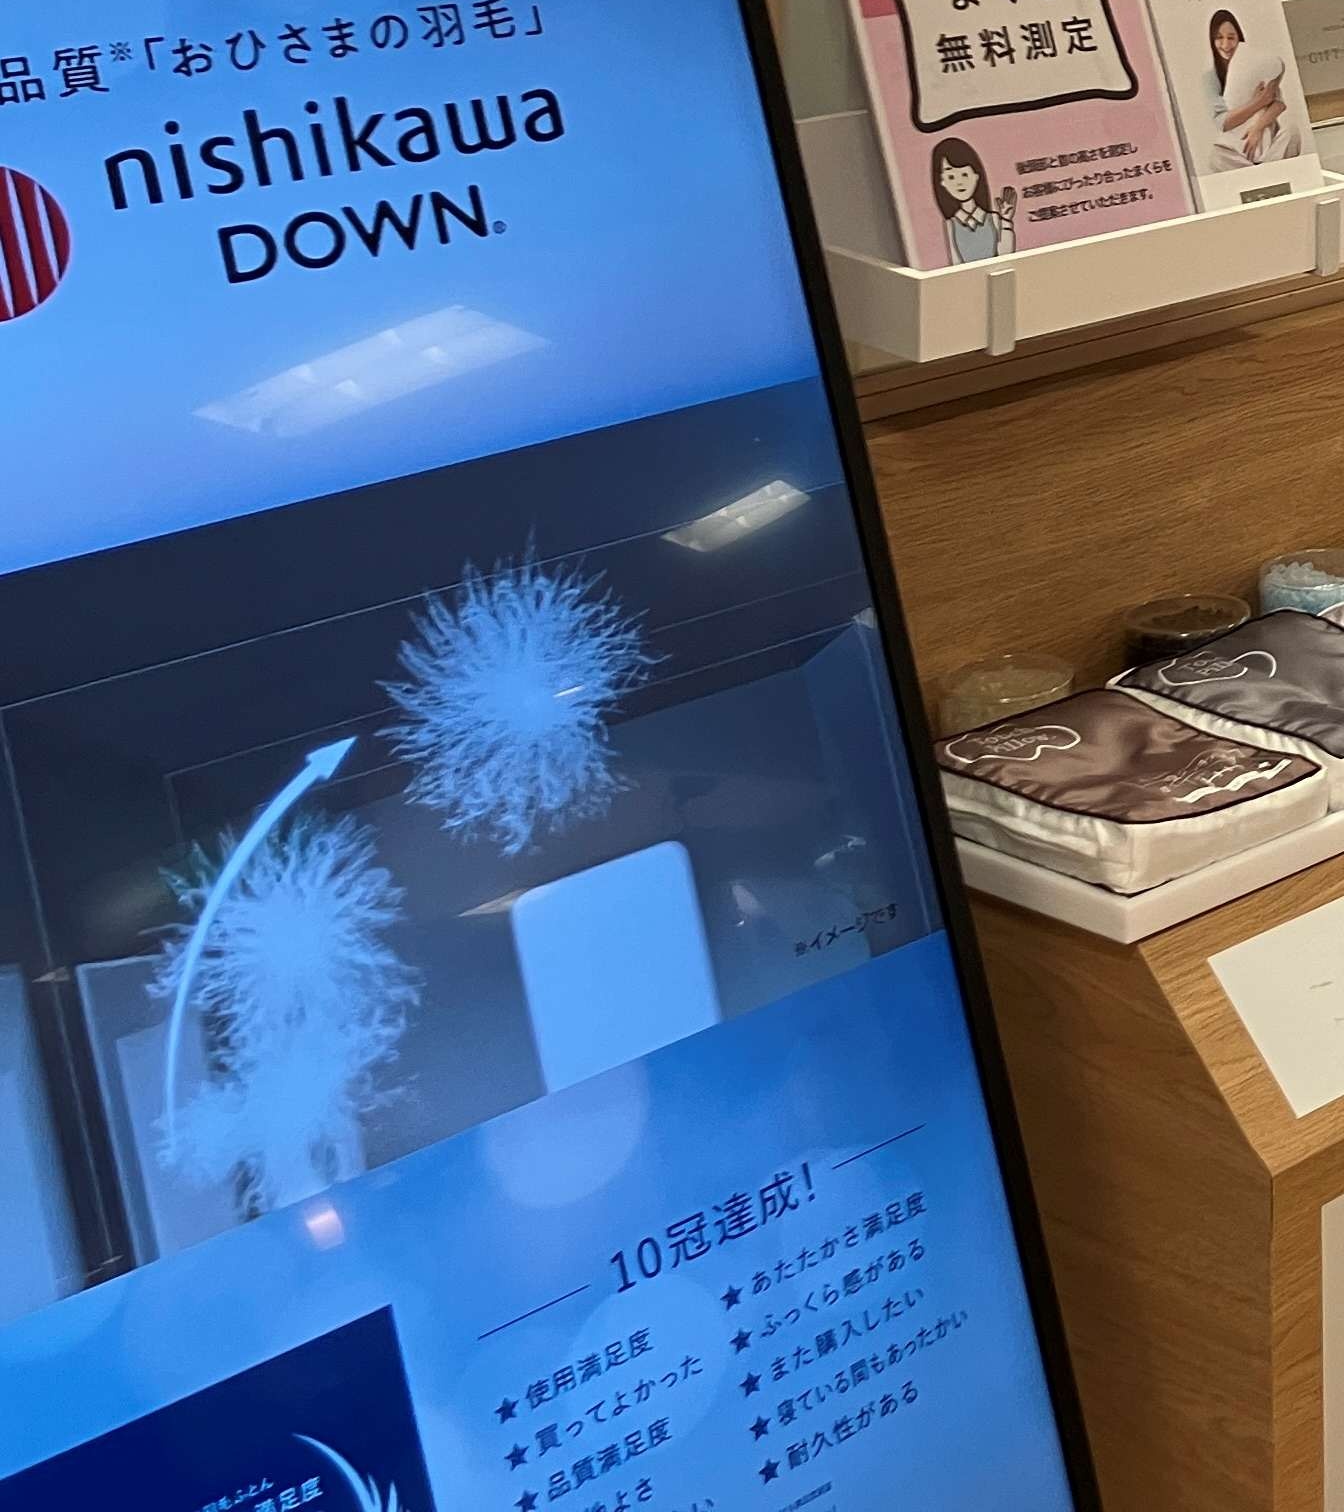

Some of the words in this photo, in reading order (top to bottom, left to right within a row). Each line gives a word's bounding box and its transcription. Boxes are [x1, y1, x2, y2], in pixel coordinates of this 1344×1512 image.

[936, 16, 1099, 75] 無料測定
[105, 87, 565, 210] nishikawa
[611, 1162, 816, 1295] 10冠達成!
[752, 1191, 928, 1295] あたたかさ満足度
[761, 1238, 925, 1338] ふっくら感がある
[770, 1288, 924, 1381] また購入したい
[525, 1327, 654, 1409] 使用満足度
[534, 1355, 703, 1456] 買ってよかった
[776, 1310, 968, 1426] 寝ている間もあったかい
[546, 1417, 673, 1502] 品質満足度
[786, 1380, 919, 1470] 耐久性がある
